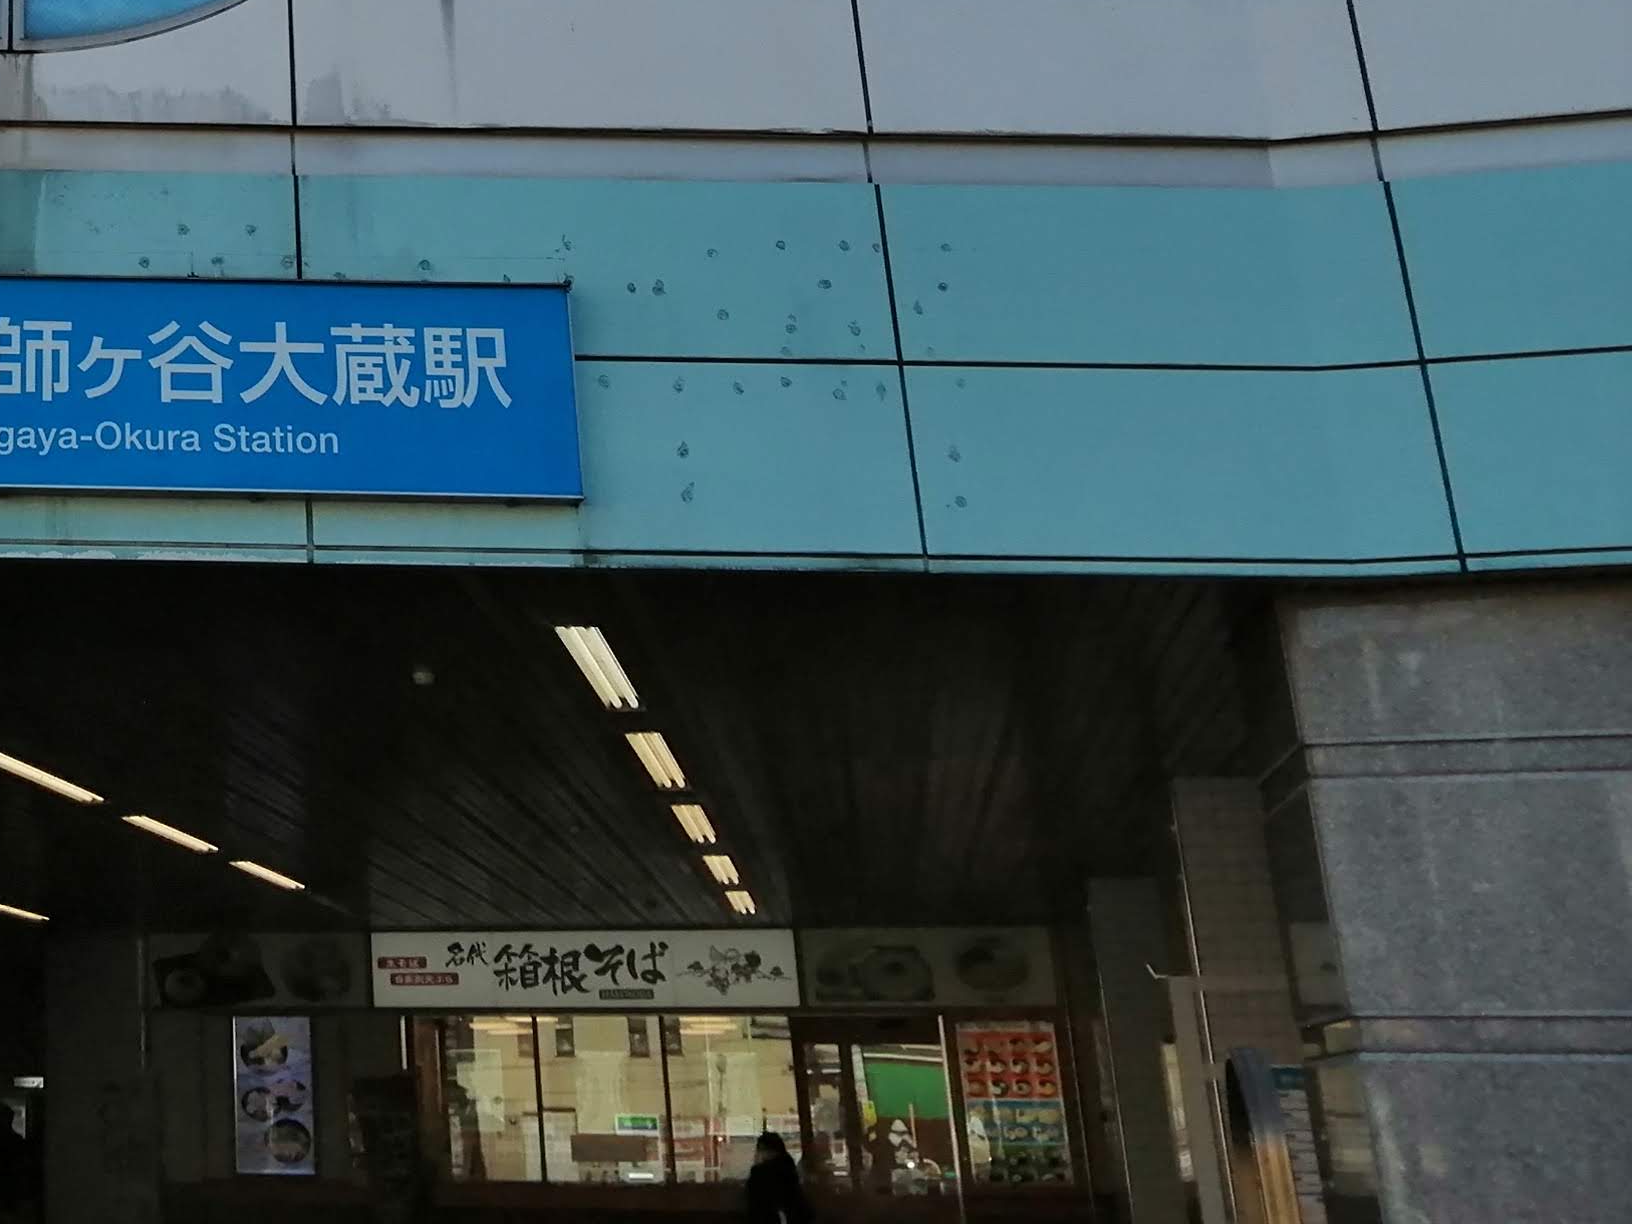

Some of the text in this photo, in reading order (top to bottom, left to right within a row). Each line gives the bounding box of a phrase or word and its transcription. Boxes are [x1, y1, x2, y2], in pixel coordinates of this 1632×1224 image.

[214, 423, 340, 454] Station
[493, 941, 668, 996] 箱根そば
